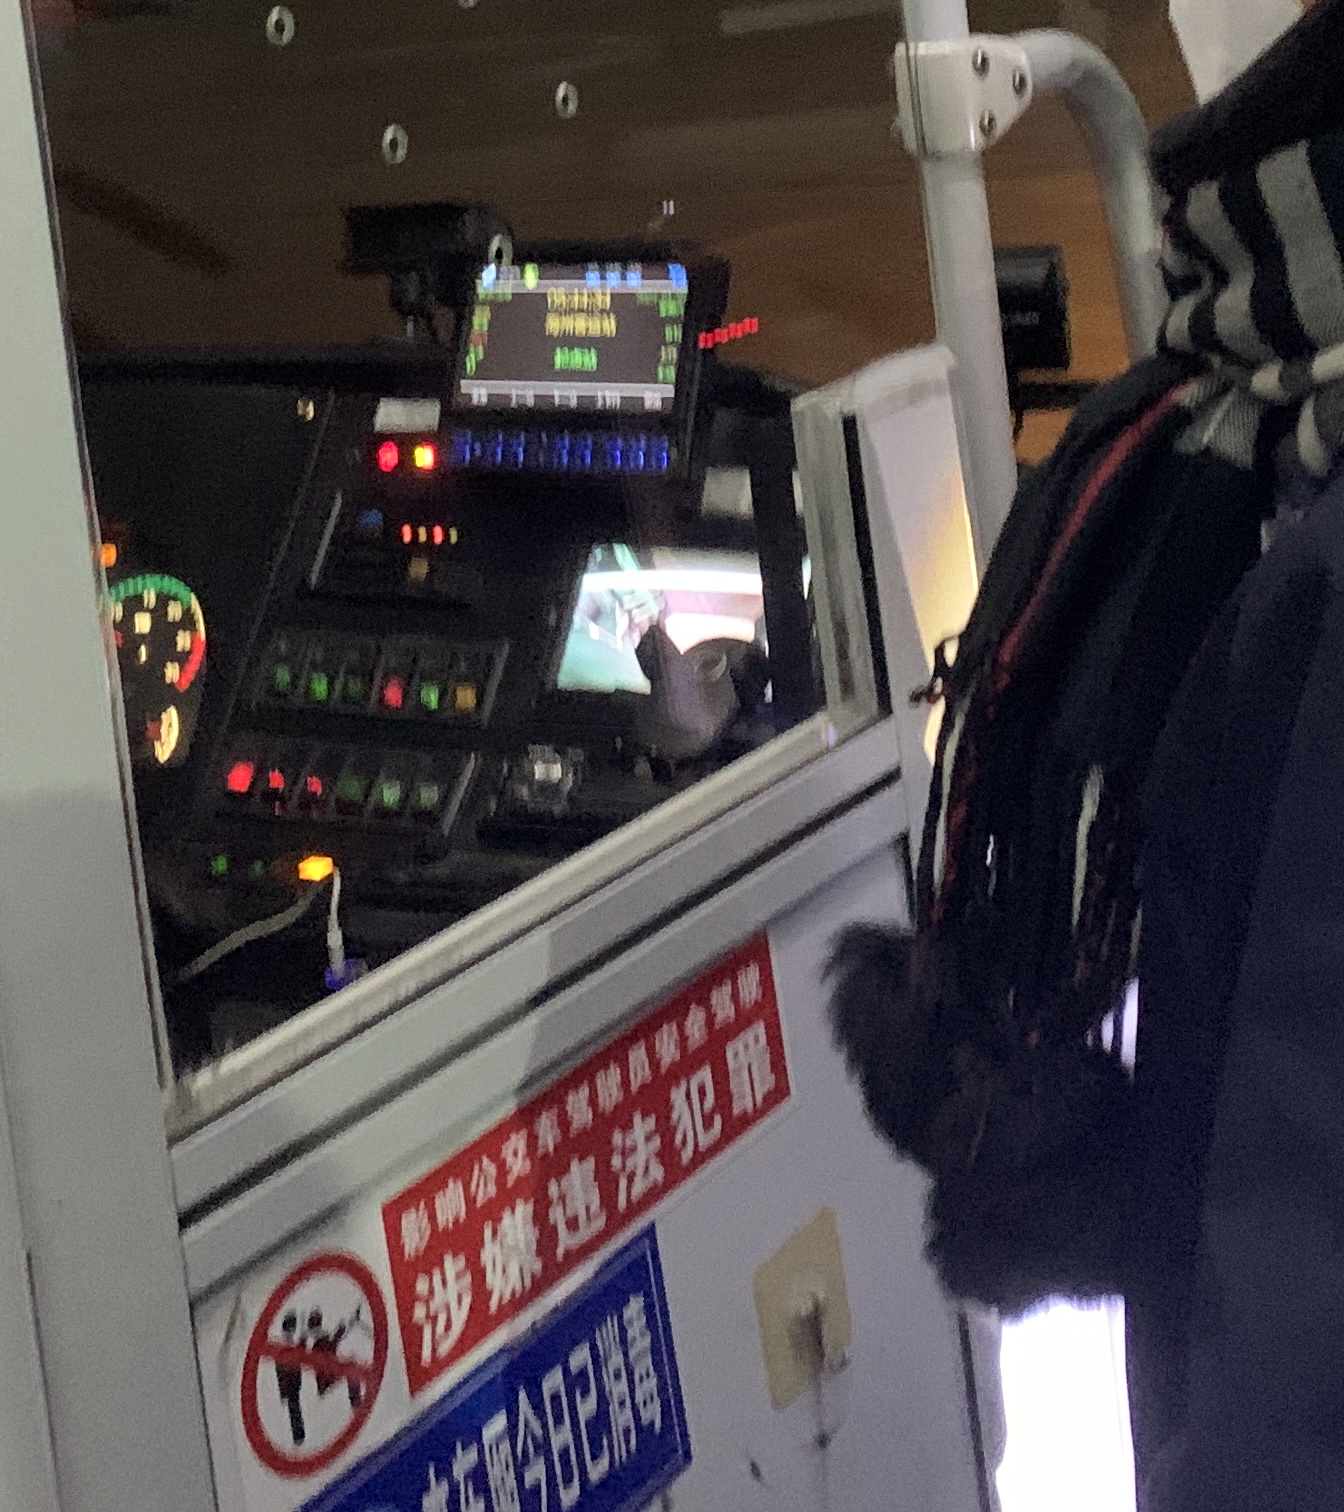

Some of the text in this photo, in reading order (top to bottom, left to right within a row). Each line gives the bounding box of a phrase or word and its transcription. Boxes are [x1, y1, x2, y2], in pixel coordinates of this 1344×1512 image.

[412, 1019, 776, 1368] 涉嫌违法犯罪
